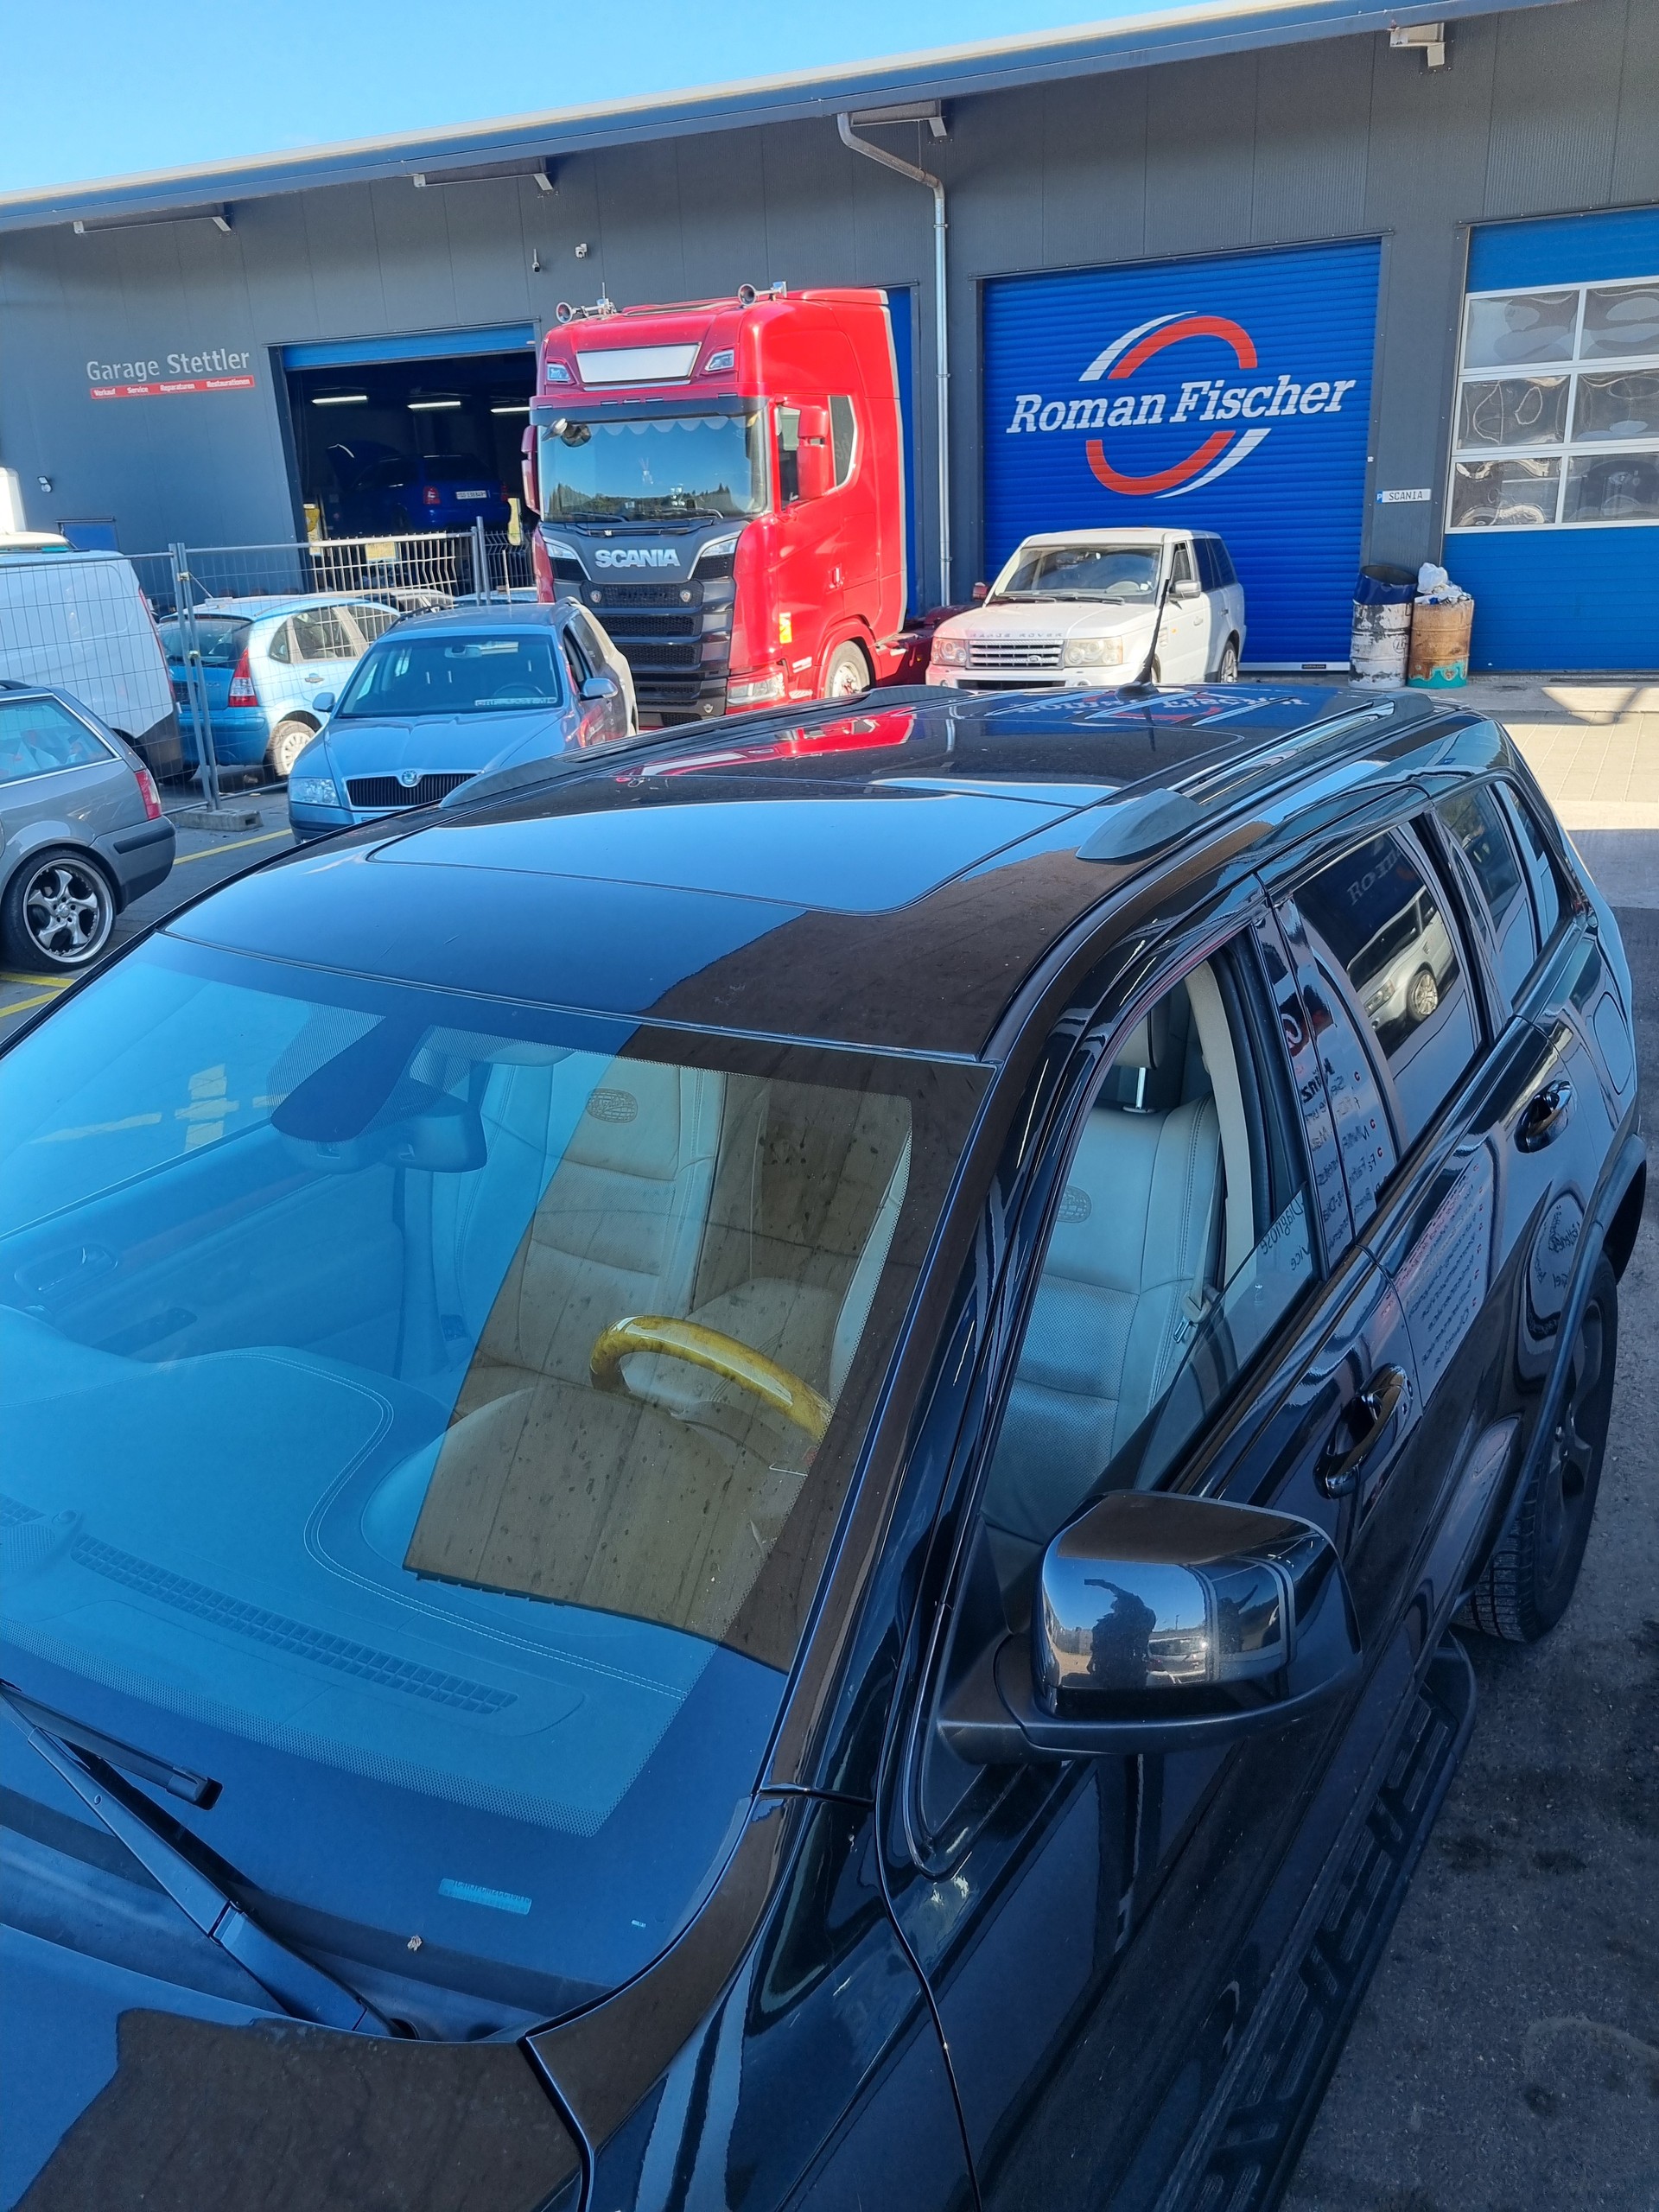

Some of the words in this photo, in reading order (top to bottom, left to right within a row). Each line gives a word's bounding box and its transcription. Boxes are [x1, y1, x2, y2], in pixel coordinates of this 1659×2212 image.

[87, 360, 160, 382] Garage
[167, 348, 250, 374] Stettler
[1006, 393, 1166, 433] Roman
[1170, 374, 1357, 423] Fischer
[1389, 491, 1423, 501] SCANIA
[594, 549, 681, 568] SCANIA
